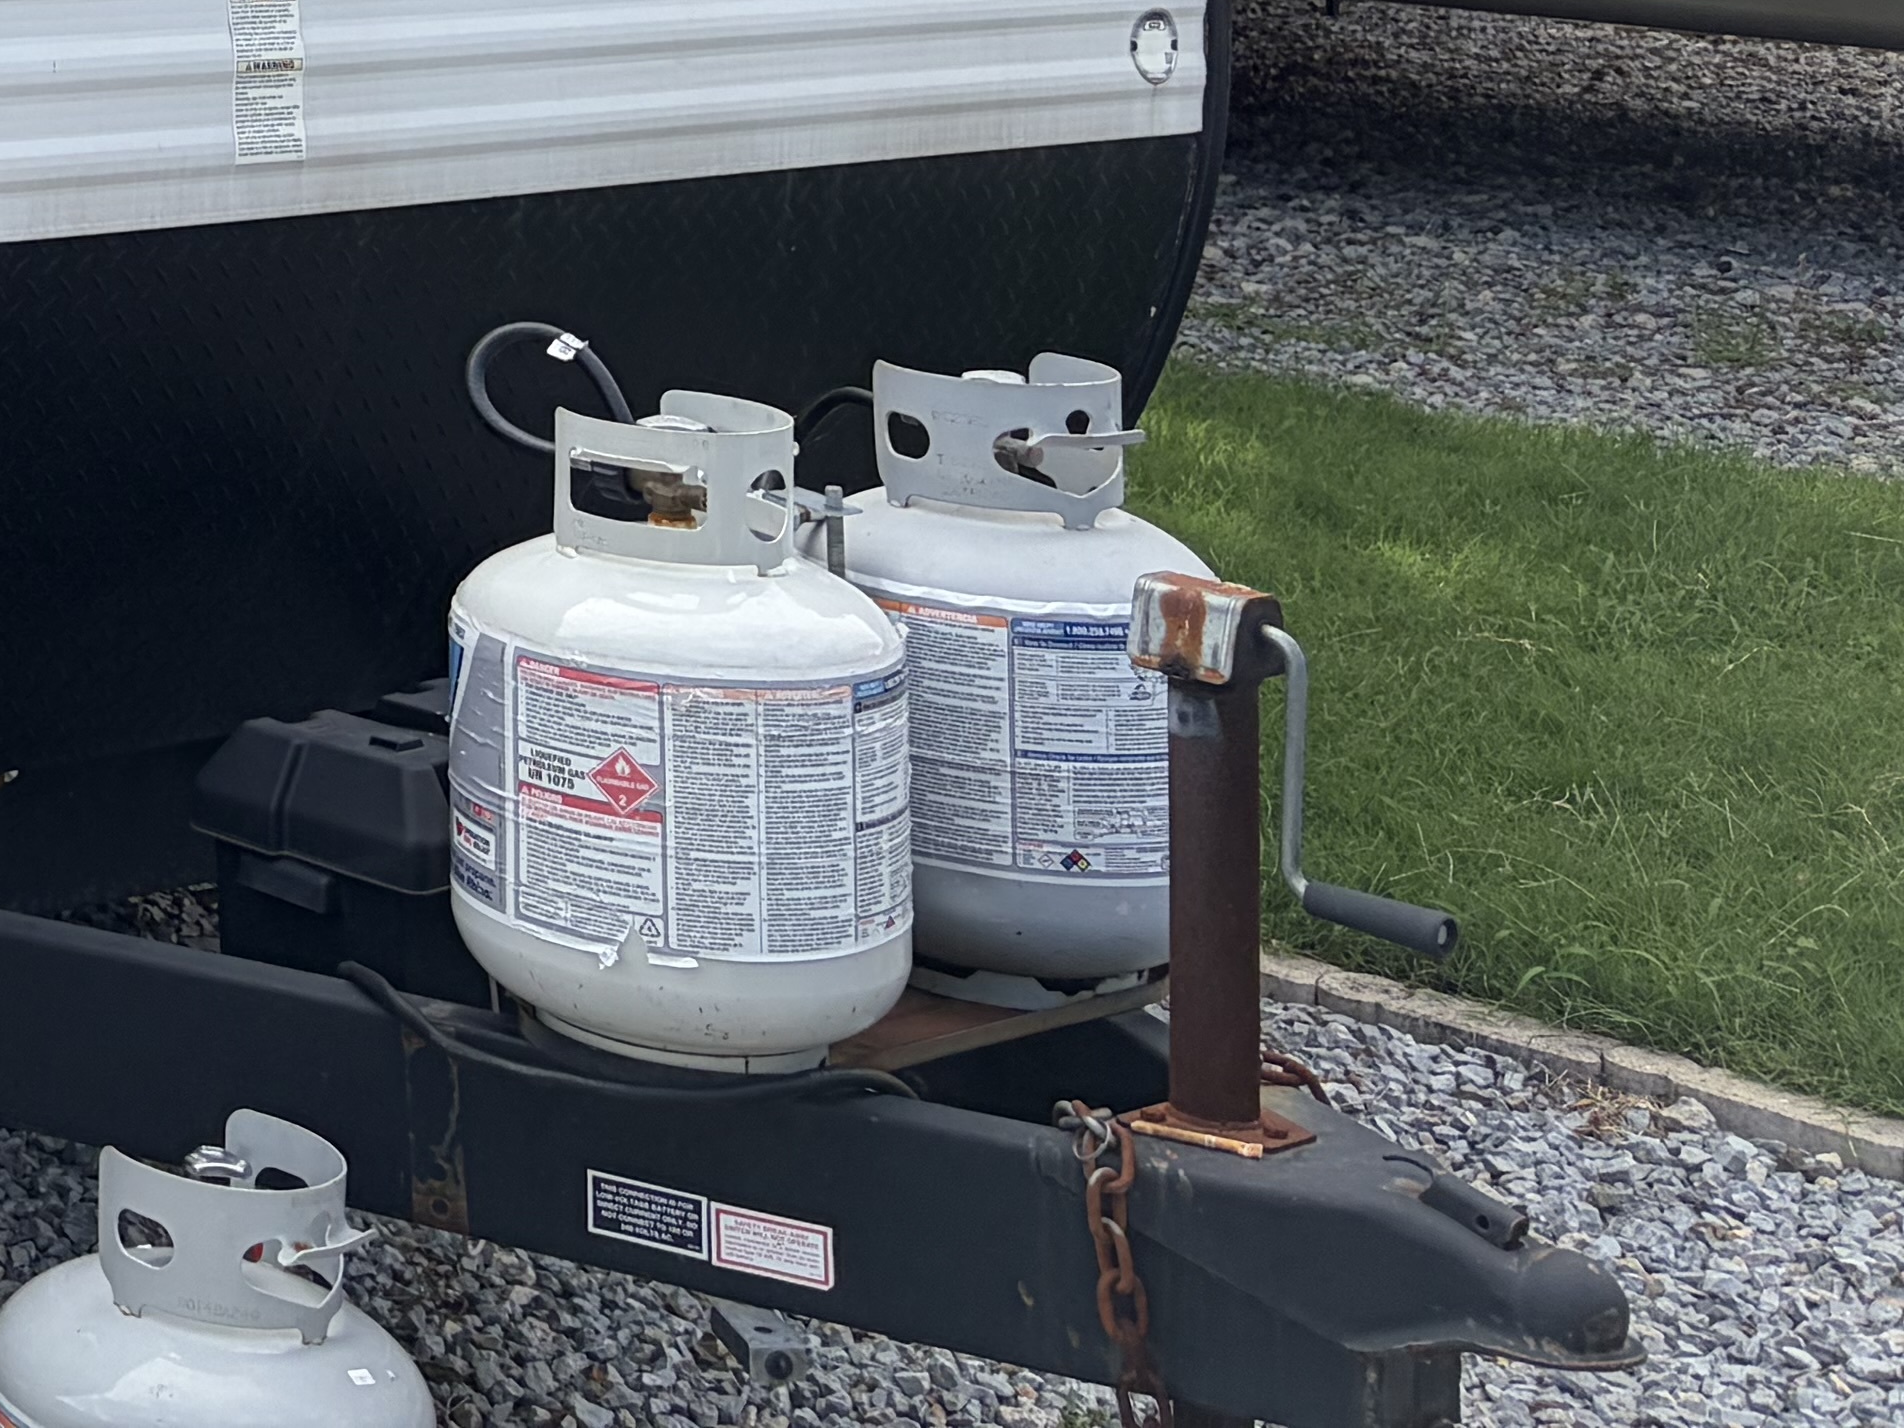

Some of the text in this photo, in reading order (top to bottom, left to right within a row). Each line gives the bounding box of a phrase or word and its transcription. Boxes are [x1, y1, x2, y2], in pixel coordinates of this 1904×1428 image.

[530, 747, 572, 767] LIQUEFIED
[547, 772, 575, 791] 1075
[567, 768, 586, 781] GAS
[618, 794, 628, 807] 2
